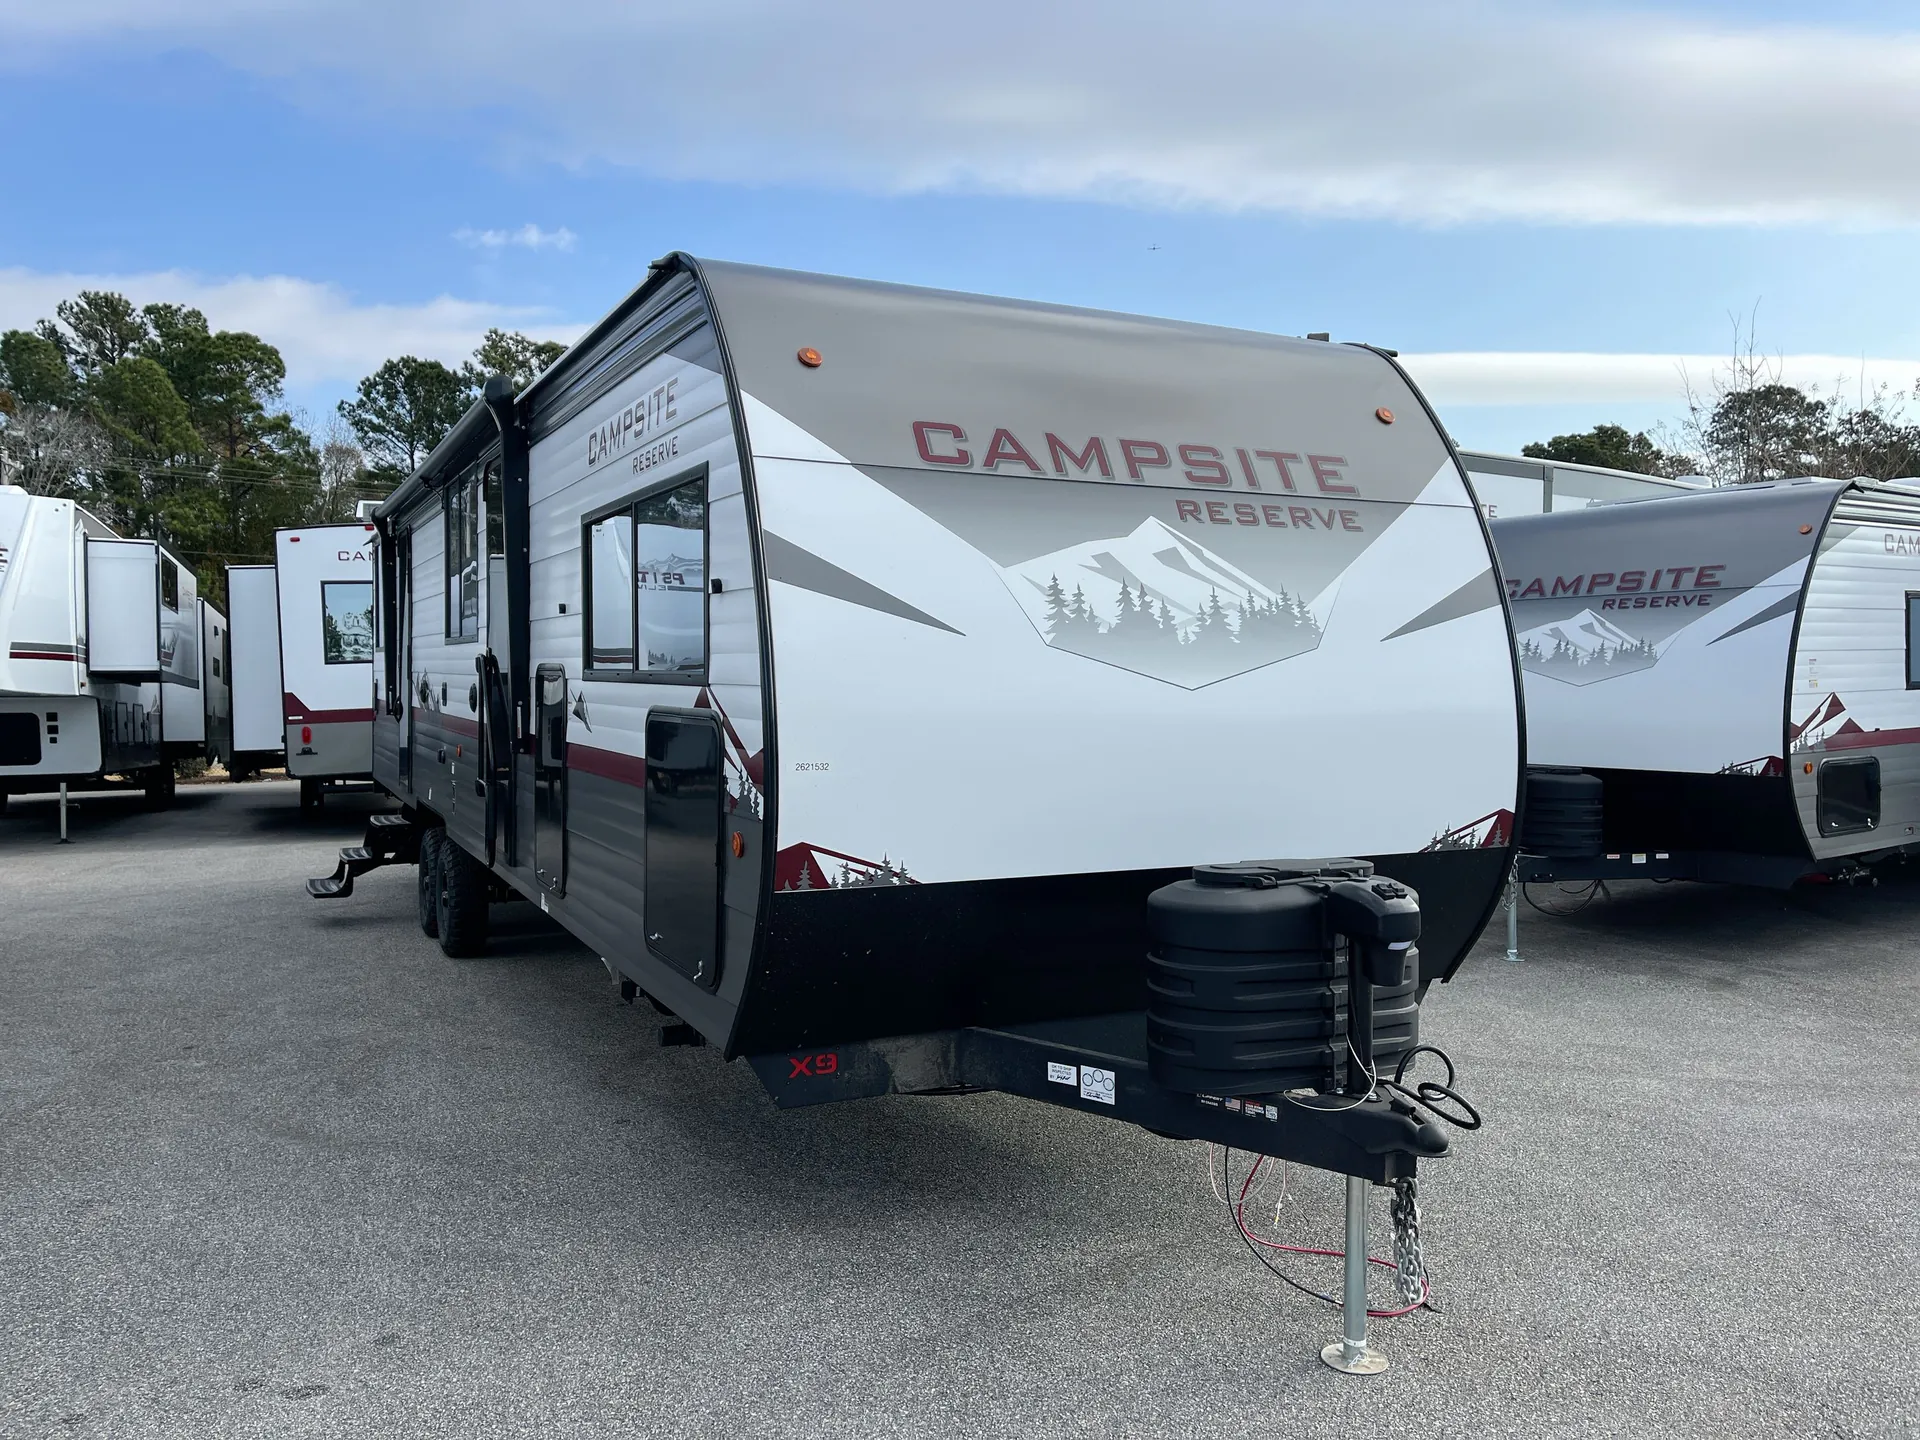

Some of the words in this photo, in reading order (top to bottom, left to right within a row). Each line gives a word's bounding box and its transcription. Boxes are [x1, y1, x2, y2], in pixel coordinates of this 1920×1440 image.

[588, 377, 678, 466] CAMPSITE
[632, 435, 678, 475] RESERVE
[912, 420, 1361, 497] CAMPSITE
[1176, 499, 1363, 532] RESERVE
[1602, 593, 1712, 610] RESERVE
[795, 762, 830, 772] 2621532
[788, 1053, 839, 1079] X9
